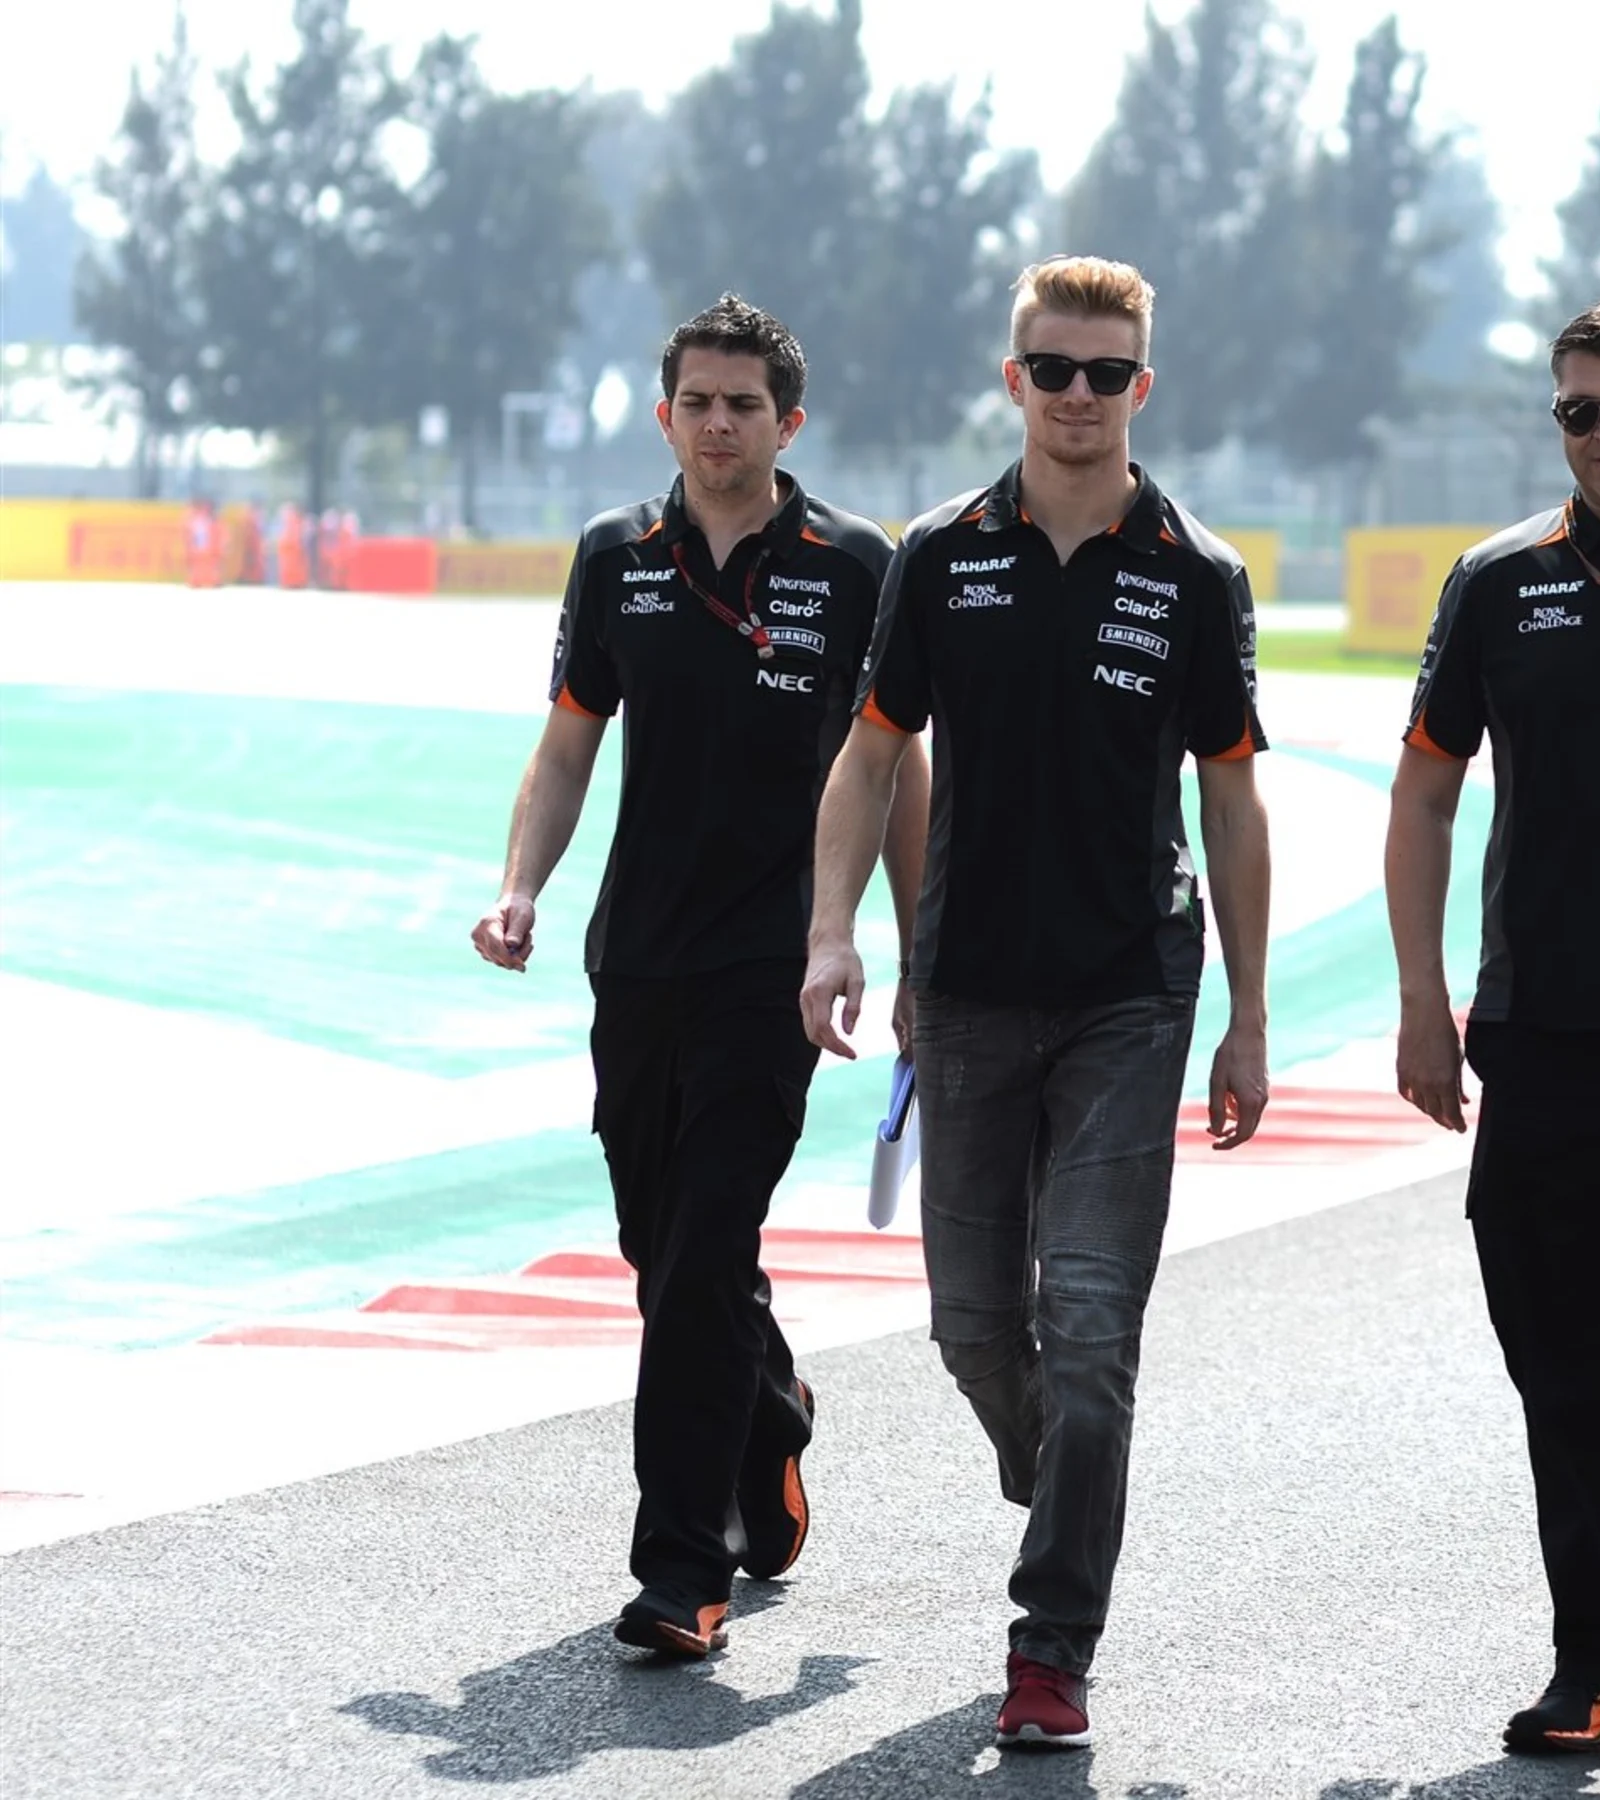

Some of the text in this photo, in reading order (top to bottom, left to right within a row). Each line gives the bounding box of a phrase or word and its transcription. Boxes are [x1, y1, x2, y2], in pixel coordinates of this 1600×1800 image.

[950, 557, 1011, 574] SAHARA
[622, 569, 672, 582] SAHARA
[768, 575, 831, 597] KINGFISHER
[963, 584, 998, 598] ROYAL
[1115, 570, 1179, 601] KINGFISHER
[1518, 582, 1579, 598] SAHARA
[633, 591, 660, 604] ROYAL
[948, 595, 1014, 610] CHALLENGE
[769, 599, 817, 618] Claro
[1114, 597, 1164, 620] Claro
[1533, 606, 1566, 620] ROYAL
[1518, 616, 1583, 633] CHALLENGE
[756, 668, 814, 693] NEC
[1093, 664, 1156, 696] NEC
